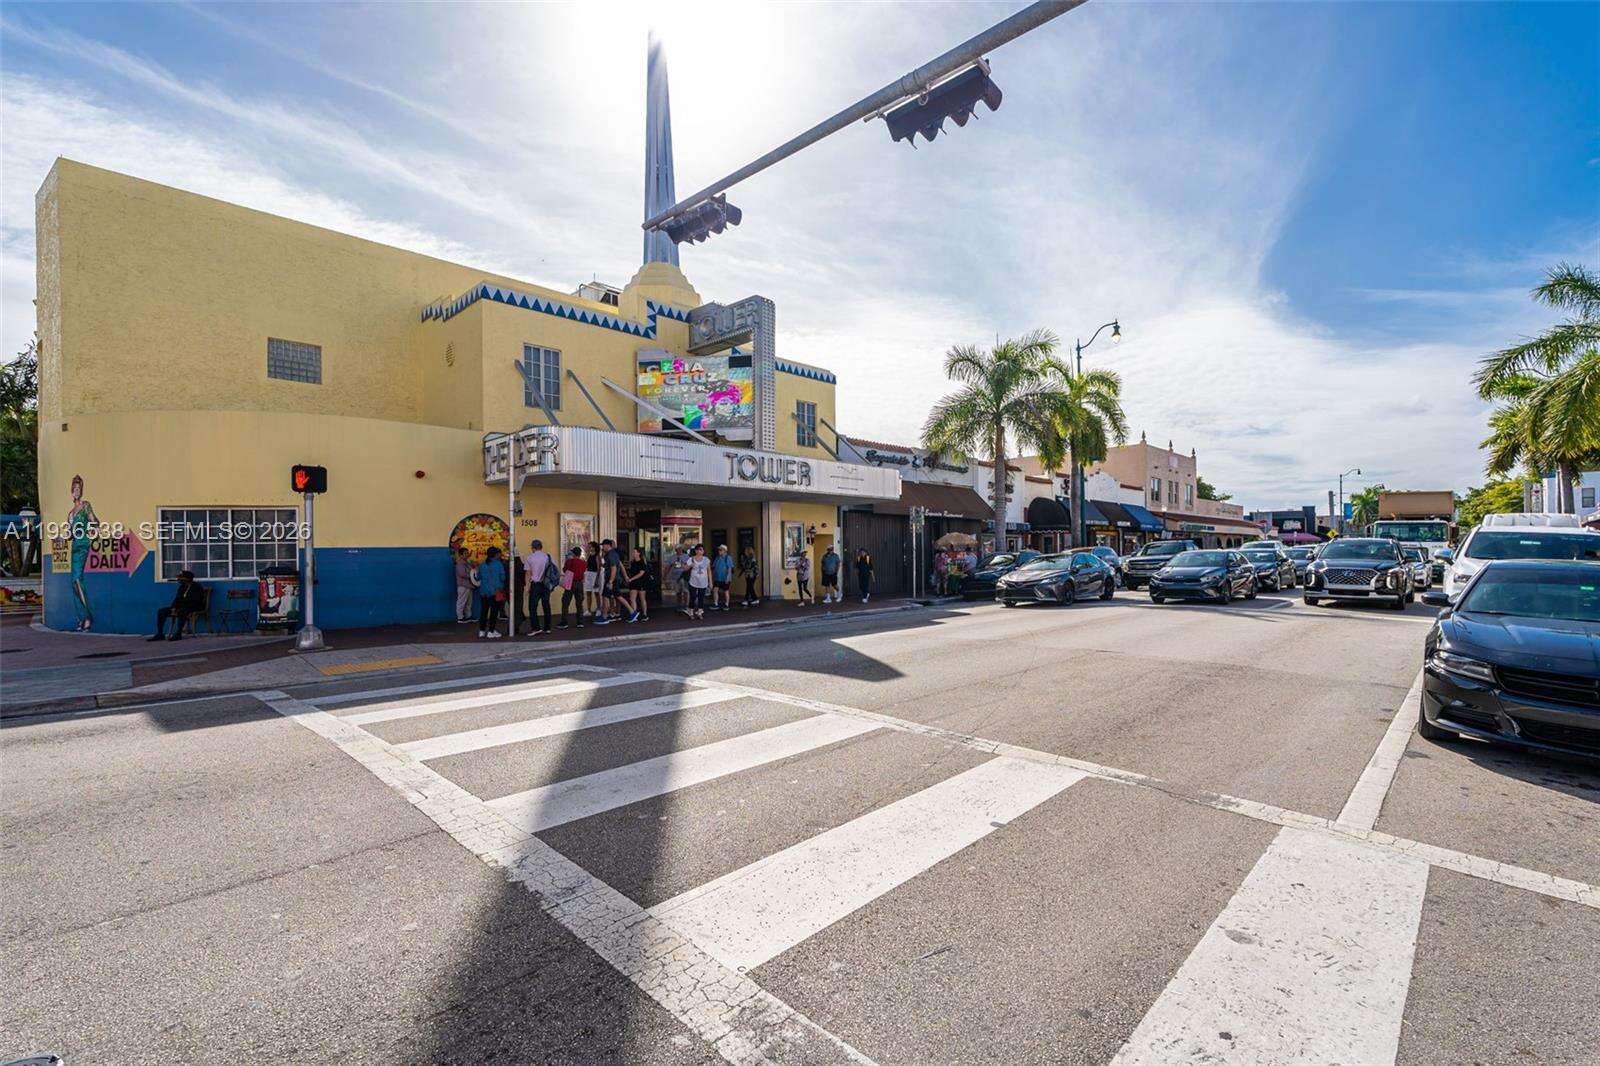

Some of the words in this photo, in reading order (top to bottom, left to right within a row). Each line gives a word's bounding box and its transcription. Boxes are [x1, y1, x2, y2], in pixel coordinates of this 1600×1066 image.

[691, 301, 758, 344] TOWER
[664, 372, 718, 385] CRUZ
[723, 452, 811, 486] TOWER
[91, 535, 130, 552] OPEN
[90, 553, 130, 569] DAILY
